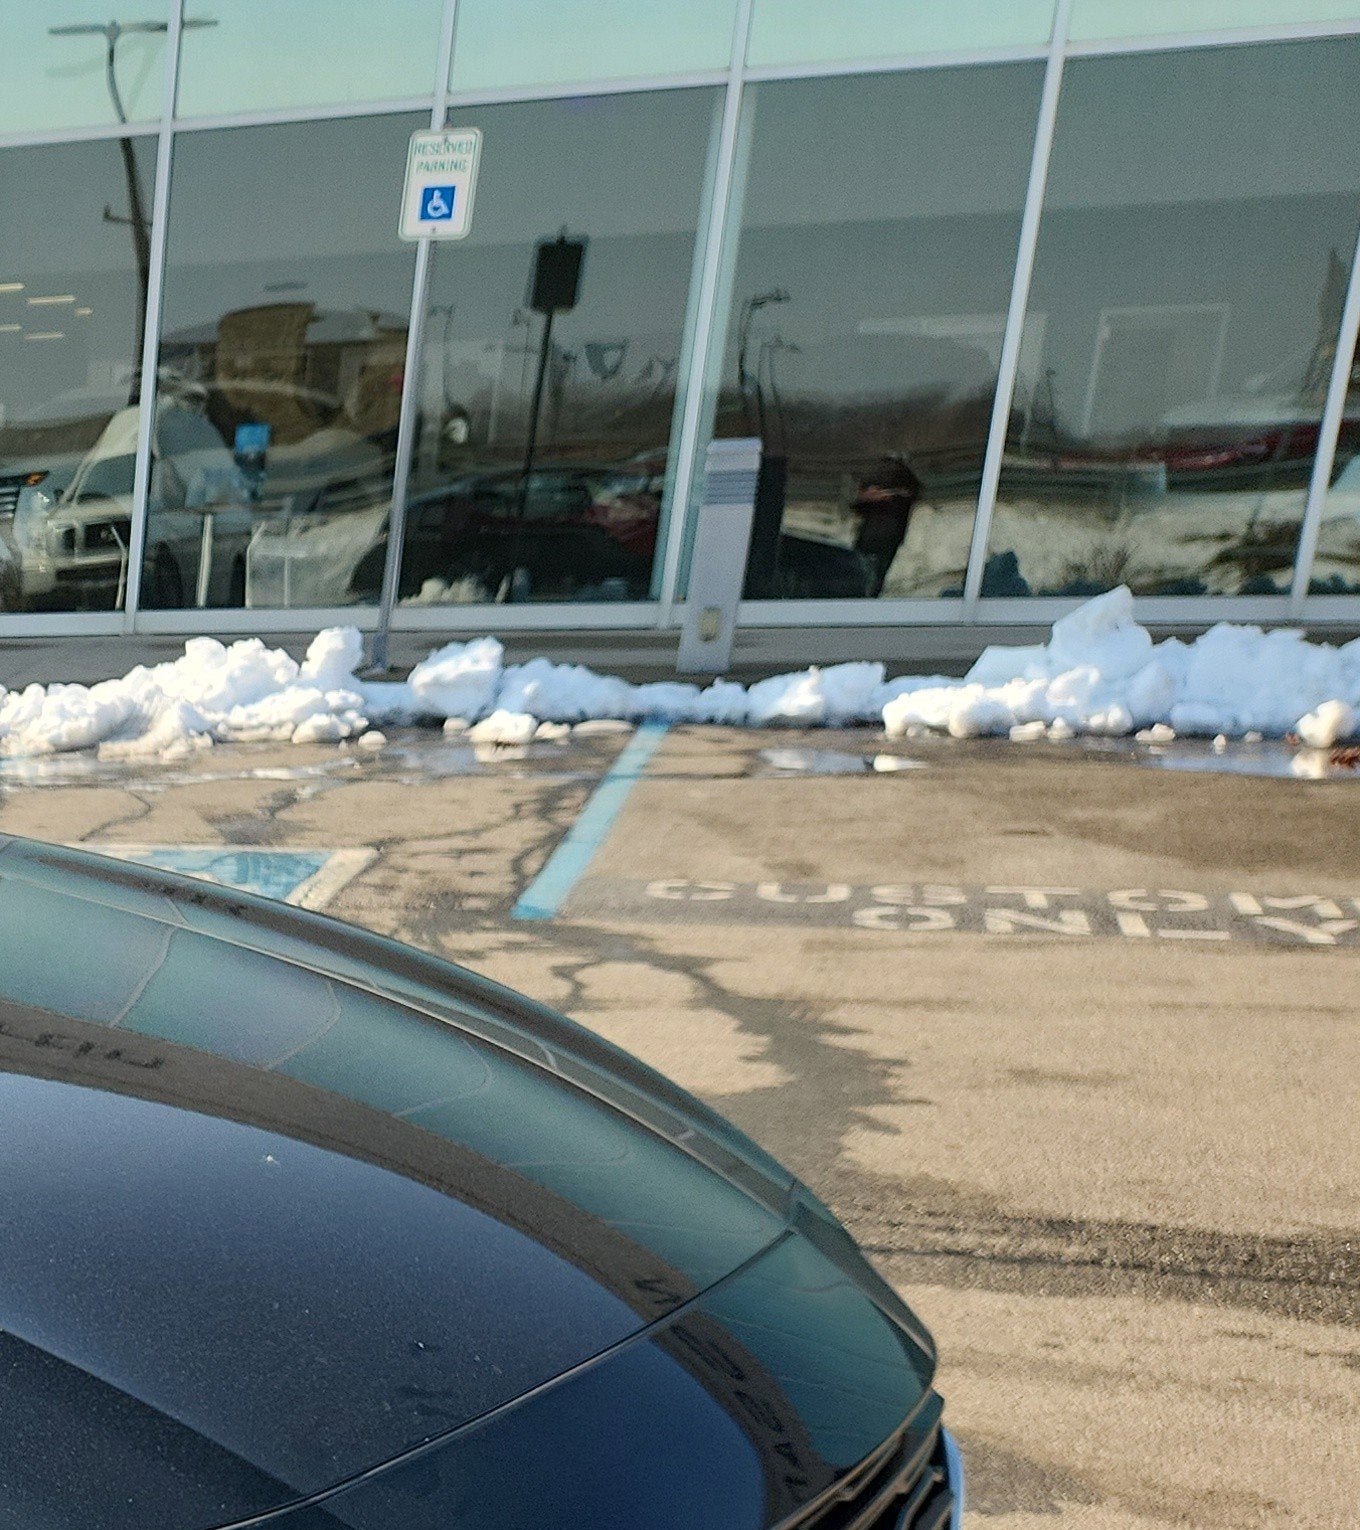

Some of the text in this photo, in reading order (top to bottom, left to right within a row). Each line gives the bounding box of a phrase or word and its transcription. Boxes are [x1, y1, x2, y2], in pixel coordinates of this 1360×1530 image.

[414, 140, 475, 156] RESERVED
[416, 158, 468, 174] PARKING
[644, 878, 1360, 919] CUSTOM
[852, 905, 1359, 945] ONLY
